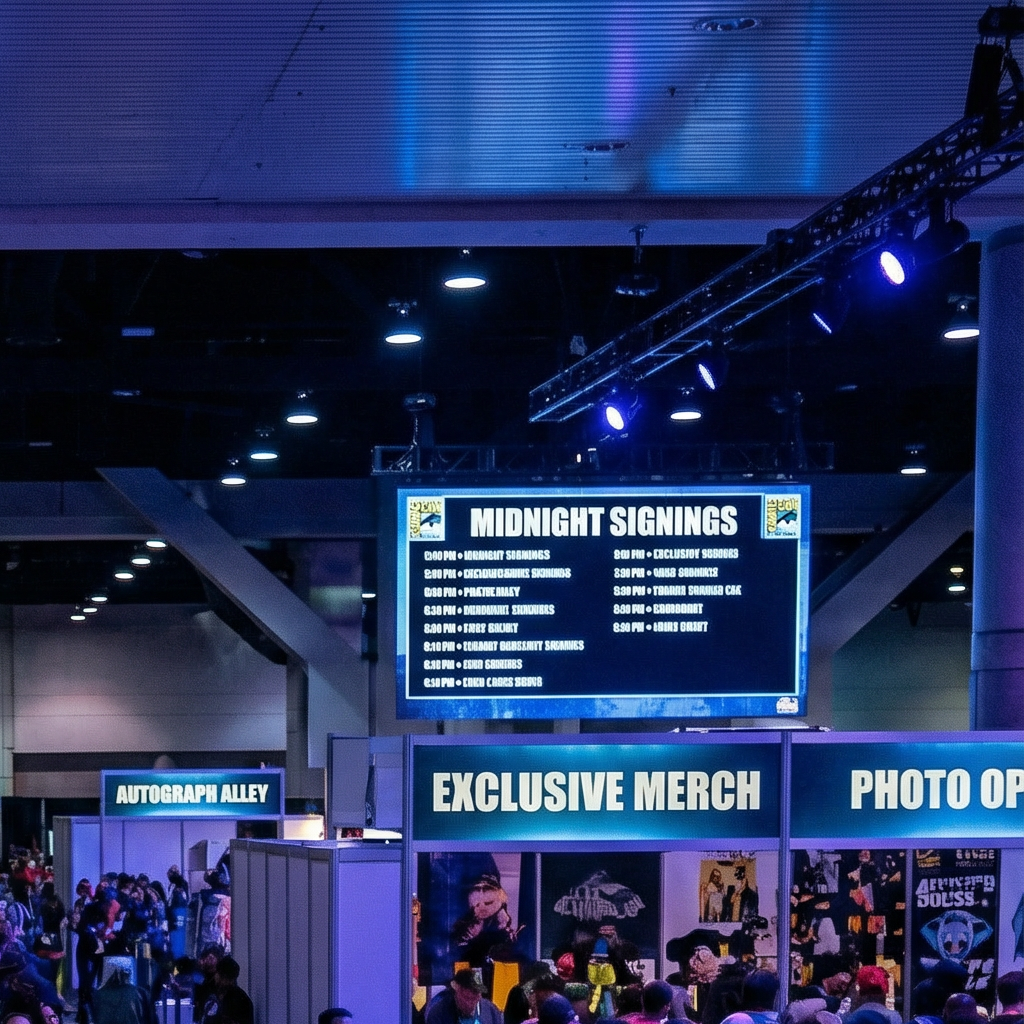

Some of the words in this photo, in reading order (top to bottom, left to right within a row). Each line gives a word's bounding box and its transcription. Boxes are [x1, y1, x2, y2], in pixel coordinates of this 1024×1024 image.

[470, 506, 605, 538] MIDNIGHT
[609, 505, 738, 536] SIGNINGS
[115, 783, 218, 805] AUTOGRAPH
[220, 783, 269, 804] ALLEY
[432, 770, 626, 813] EXCLUSIVE
[632, 769, 762, 811] MERCH
[851, 769, 971, 810] PHOTO
